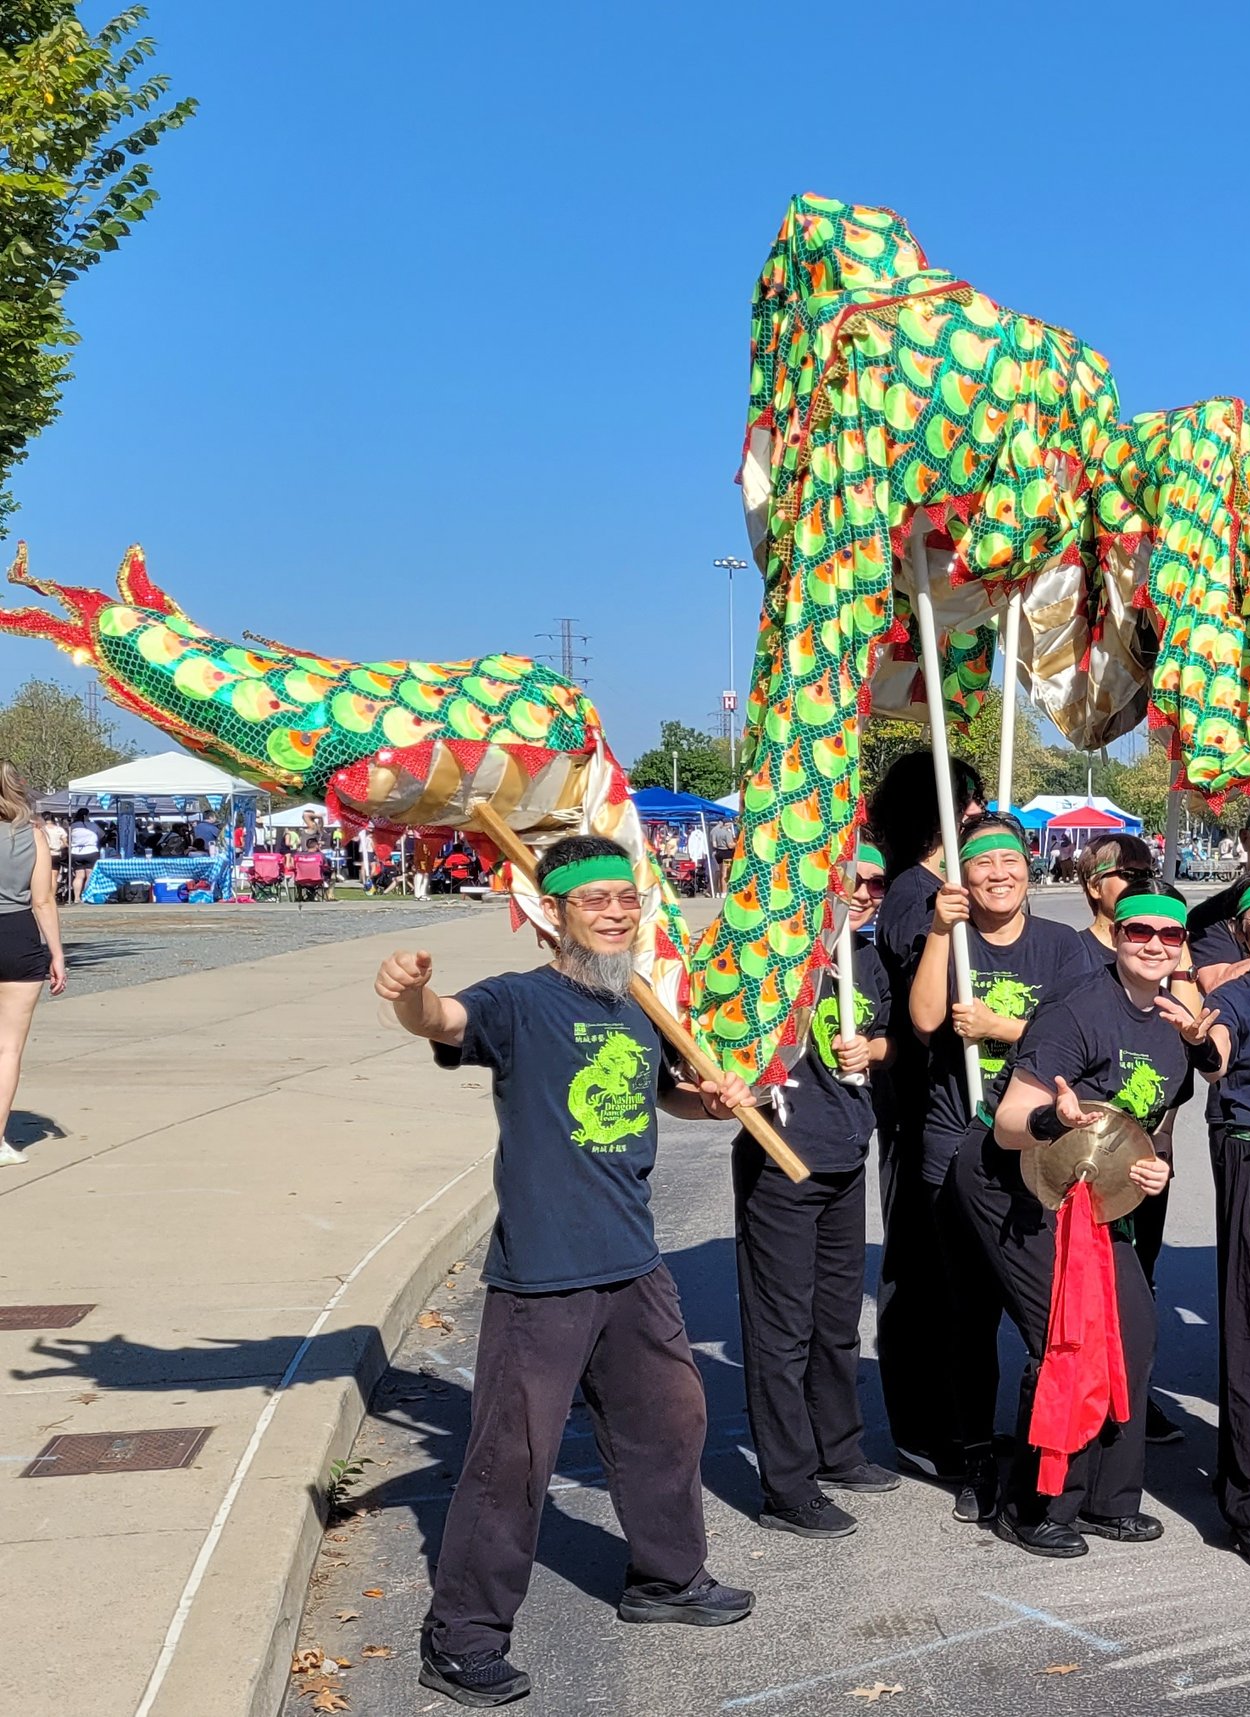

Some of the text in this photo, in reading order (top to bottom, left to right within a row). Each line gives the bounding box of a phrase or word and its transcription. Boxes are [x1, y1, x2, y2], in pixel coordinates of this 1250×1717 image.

[725, 697, 735, 709] H
[611, 1092, 646, 1104] Nashville
[605, 1102, 637, 1111] Dragon
